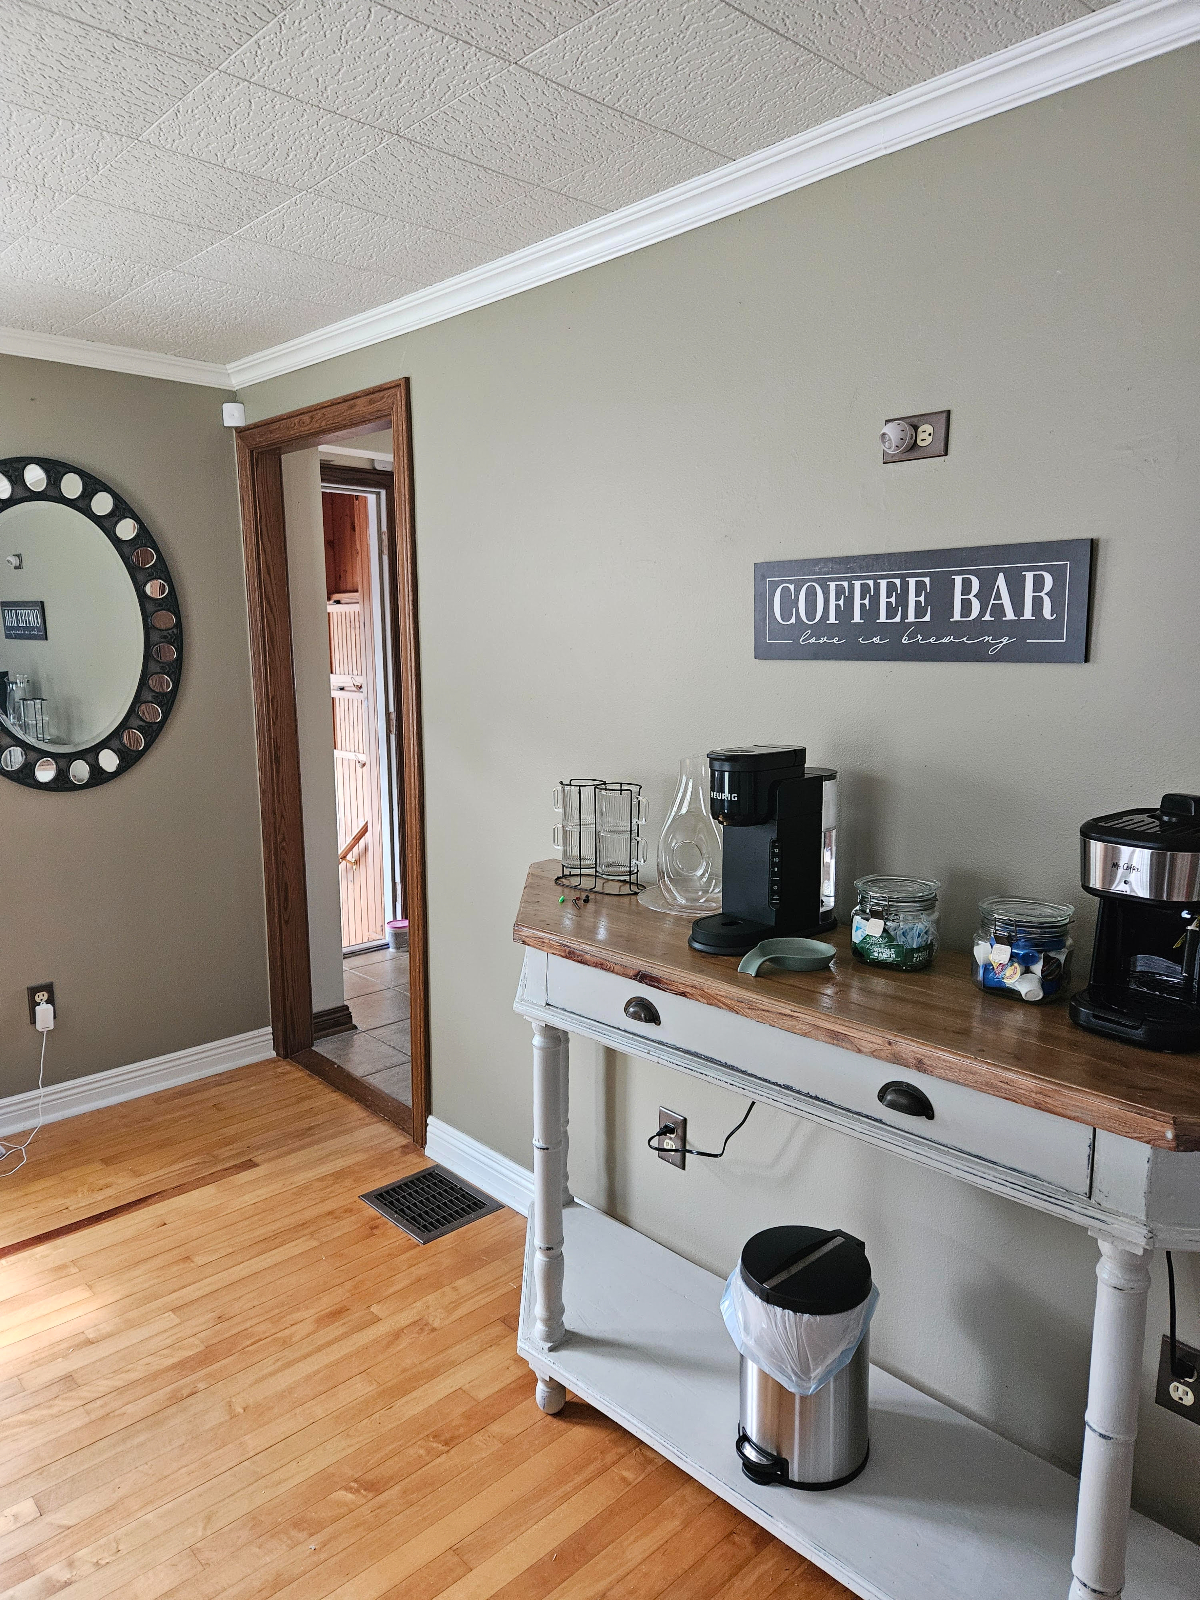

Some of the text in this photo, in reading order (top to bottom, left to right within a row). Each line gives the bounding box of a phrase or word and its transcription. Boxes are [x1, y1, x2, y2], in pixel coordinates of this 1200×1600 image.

[772, 570, 1057, 626] COFFEE BAR
[799, 626, 1017, 655] love is brewing
